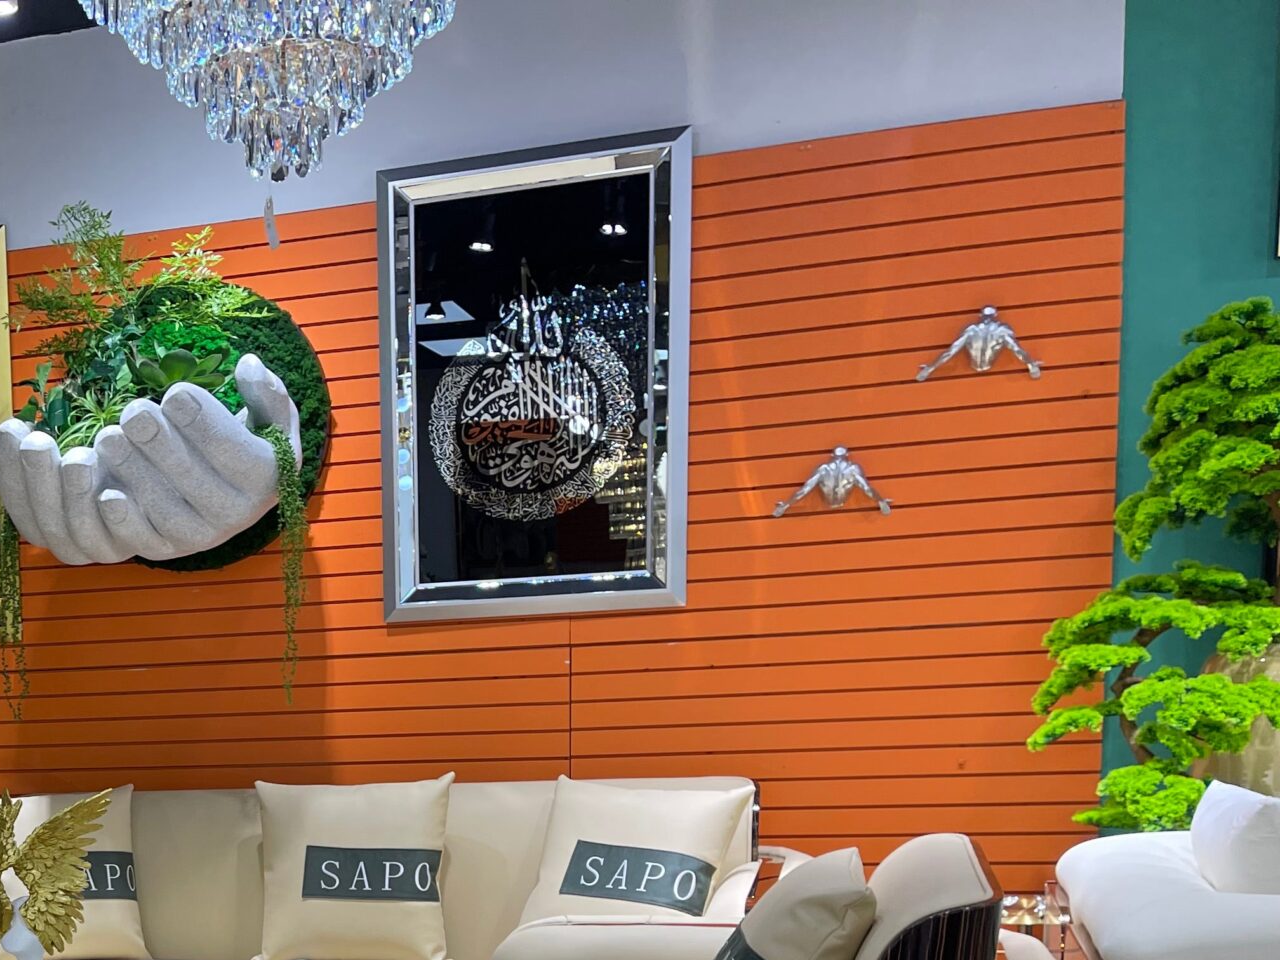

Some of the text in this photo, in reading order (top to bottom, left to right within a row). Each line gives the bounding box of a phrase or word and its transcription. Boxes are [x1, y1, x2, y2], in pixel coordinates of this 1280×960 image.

[79, 864, 136, 892] APO
[320, 860, 432, 892] SAPO
[580, 856, 697, 901] SAPO
